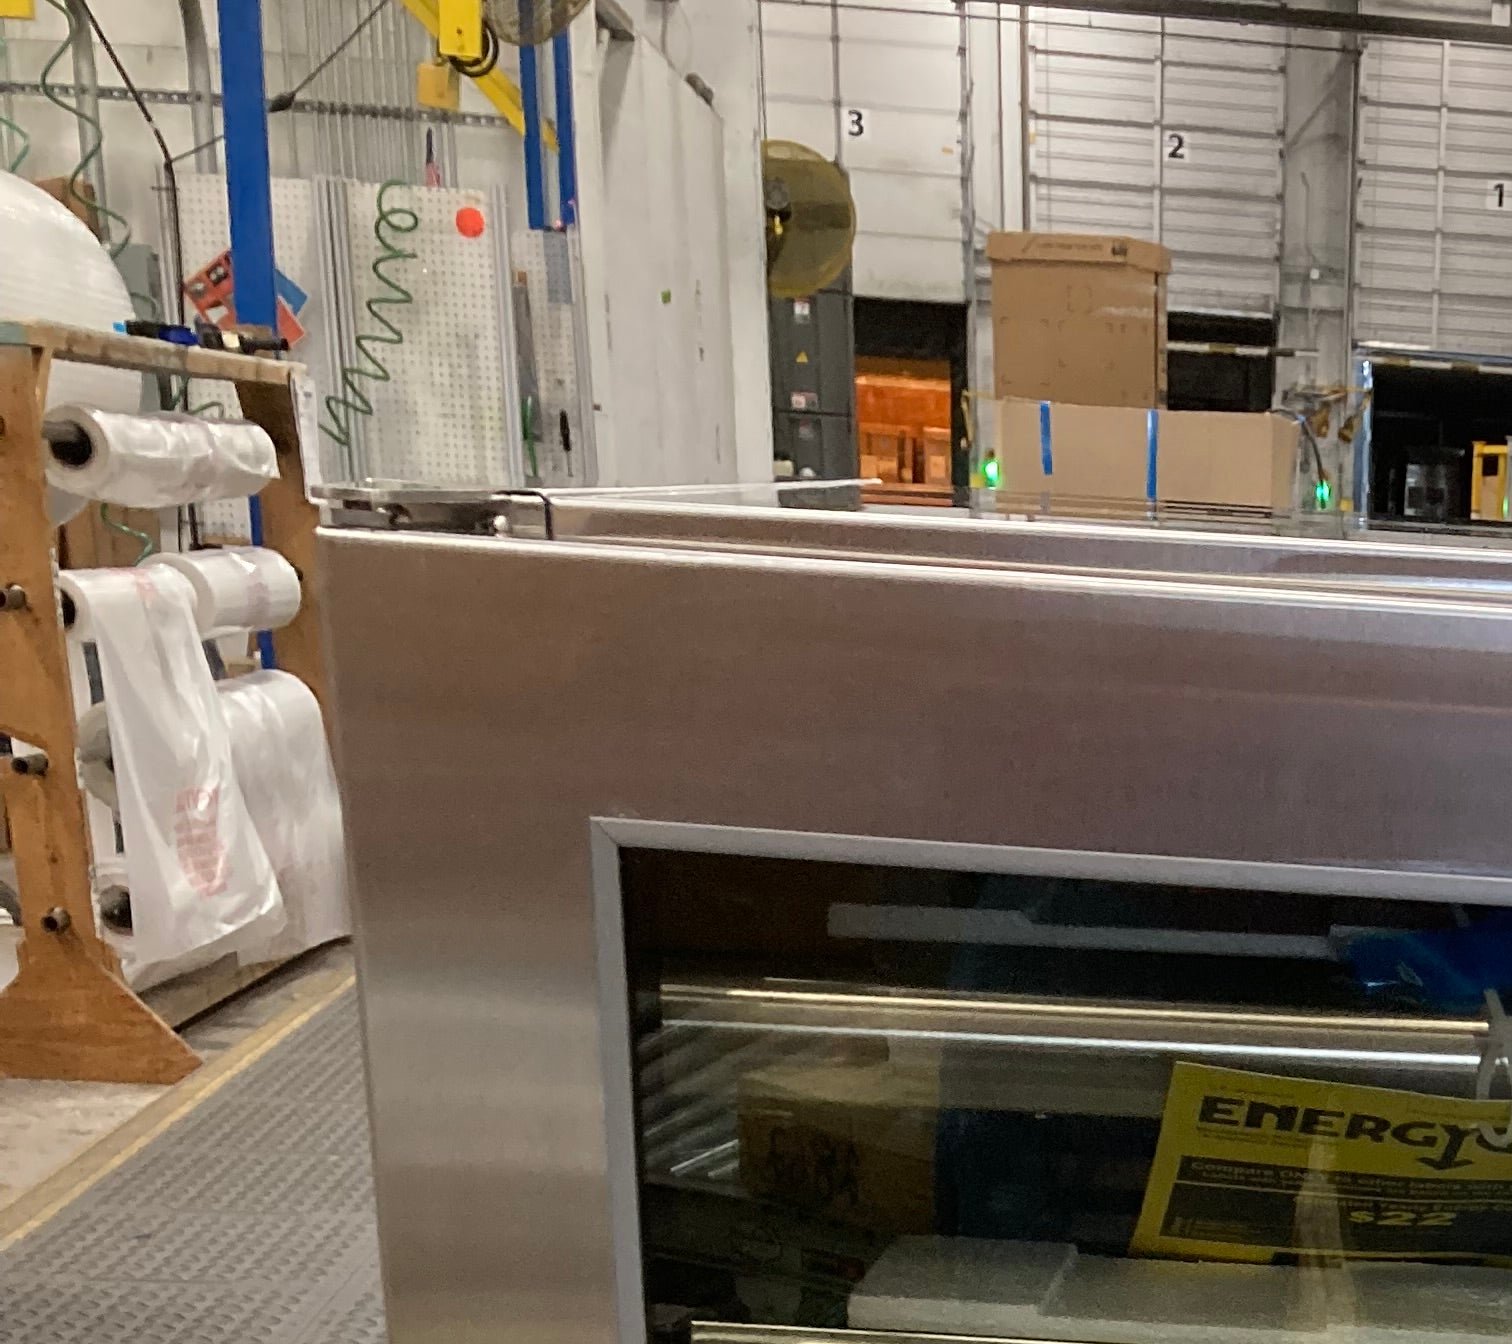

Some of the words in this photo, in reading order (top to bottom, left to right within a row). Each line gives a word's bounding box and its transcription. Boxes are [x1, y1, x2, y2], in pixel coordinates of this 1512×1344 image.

[848, 109, 864, 136] 3
[1168, 133, 1185, 159] 2
[1493, 183, 1505, 208] 1
[1349, 1210, 1458, 1227] $22
